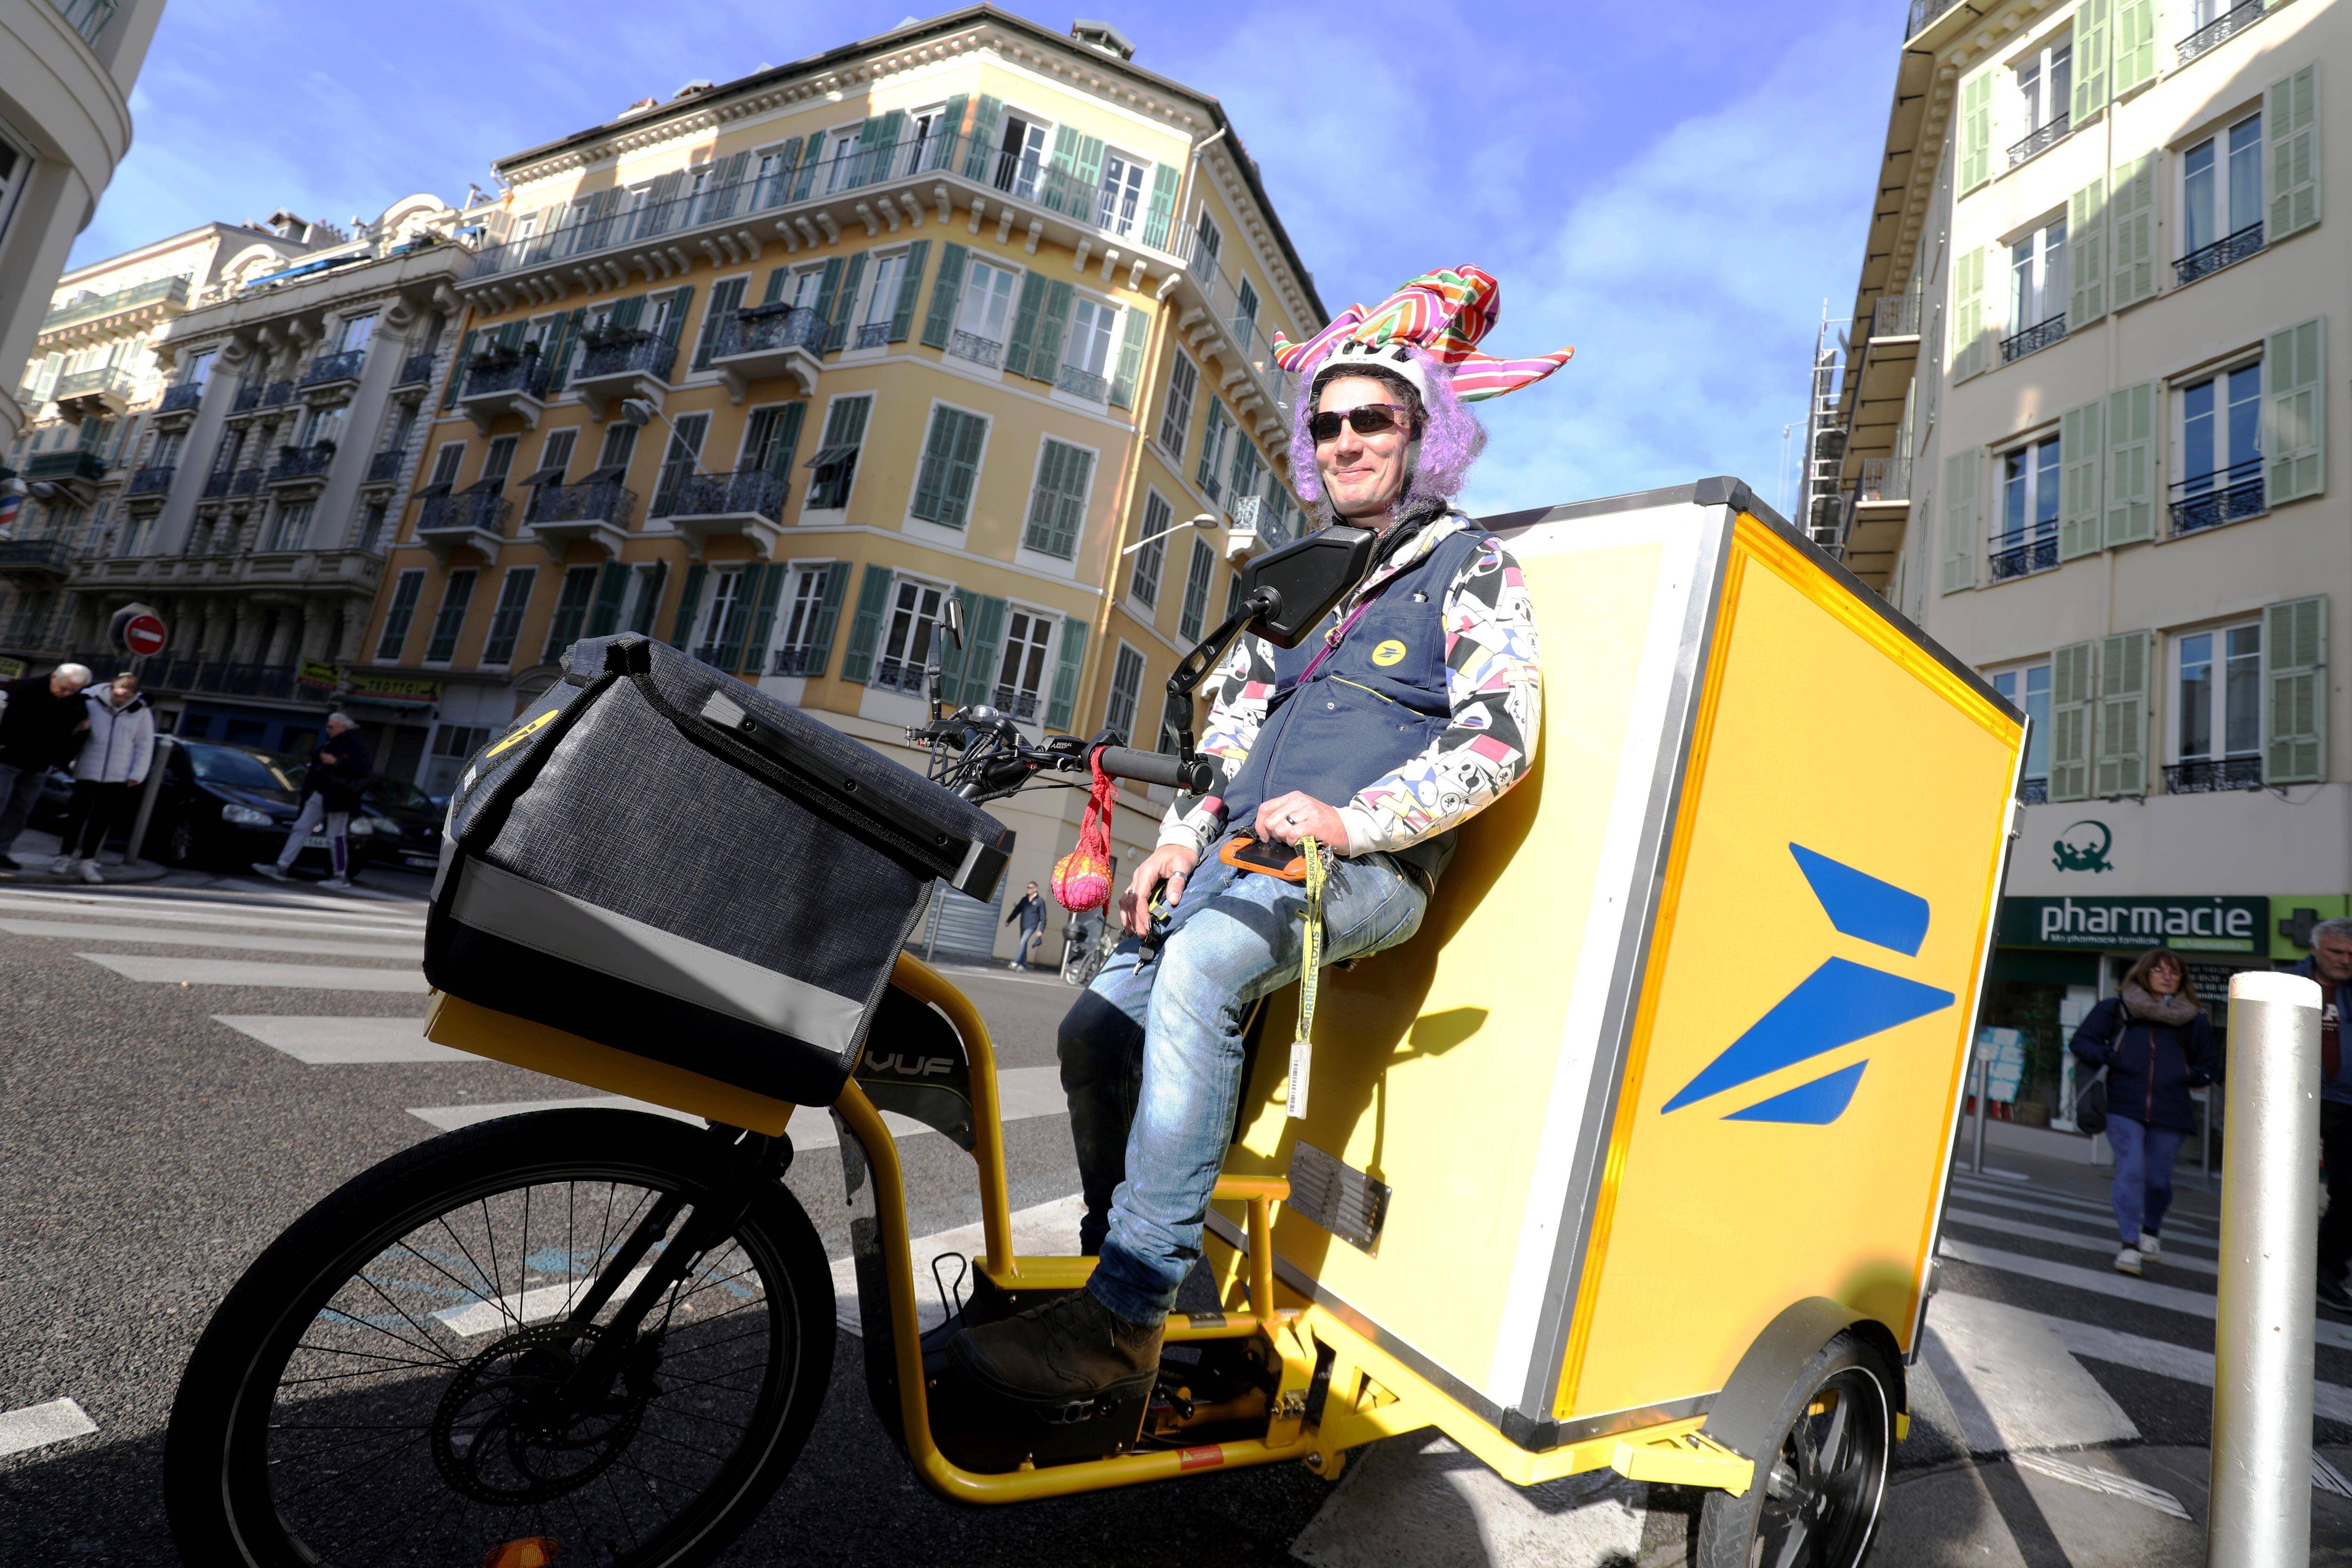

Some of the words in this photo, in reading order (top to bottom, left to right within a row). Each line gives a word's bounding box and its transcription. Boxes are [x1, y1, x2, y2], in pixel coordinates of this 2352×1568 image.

[2041, 897, 2253, 941] pharmacie
[2067, 934, 2117, 944] pharmacie
[2118, 936, 2161, 946] familiale
[1302, 931, 1320, 1039] URRIER-COLIS
[864, 1051, 954, 1076] VUF
